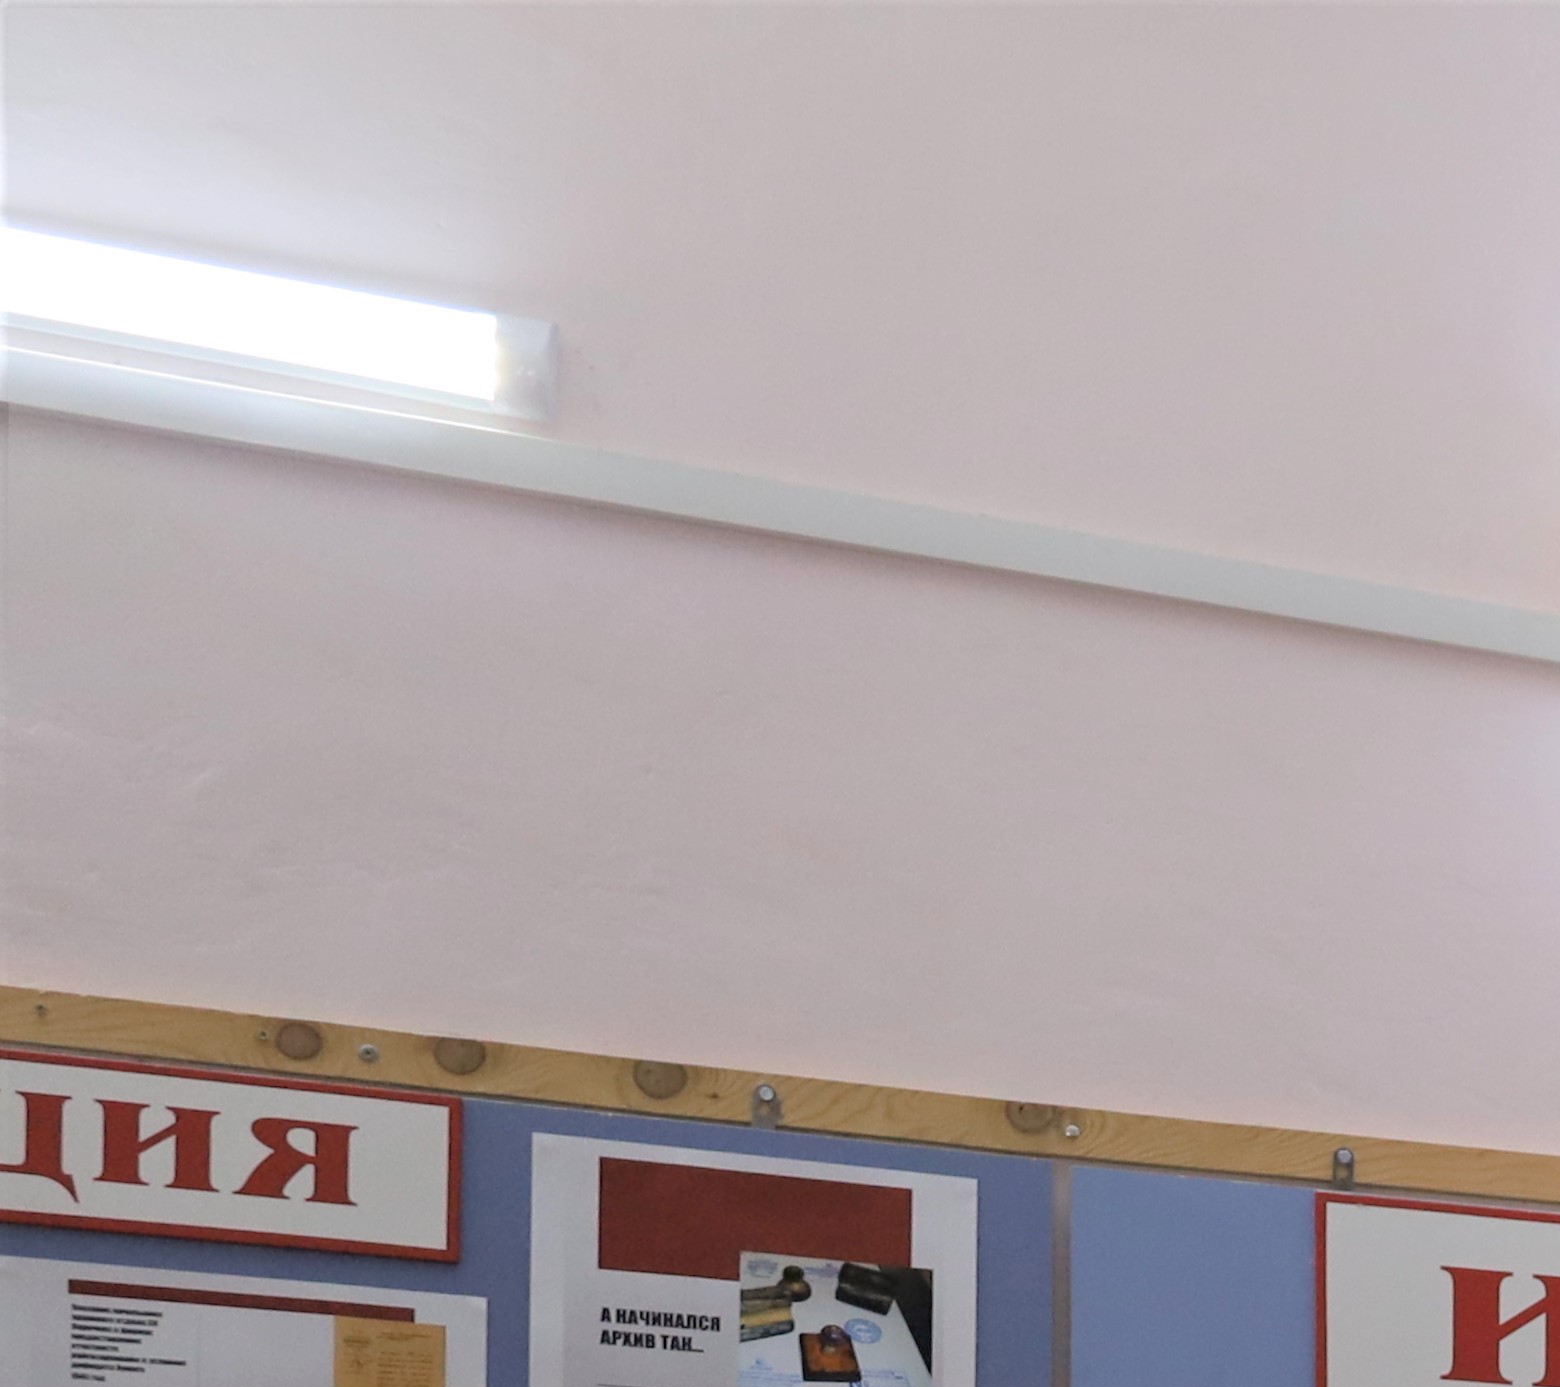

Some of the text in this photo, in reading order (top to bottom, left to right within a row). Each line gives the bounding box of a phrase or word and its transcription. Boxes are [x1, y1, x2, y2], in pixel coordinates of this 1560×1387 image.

[601, 1308, 720, 1332] А НАЧИНАЛСЯ
[600, 1330, 655, 1348] АРХИВ
